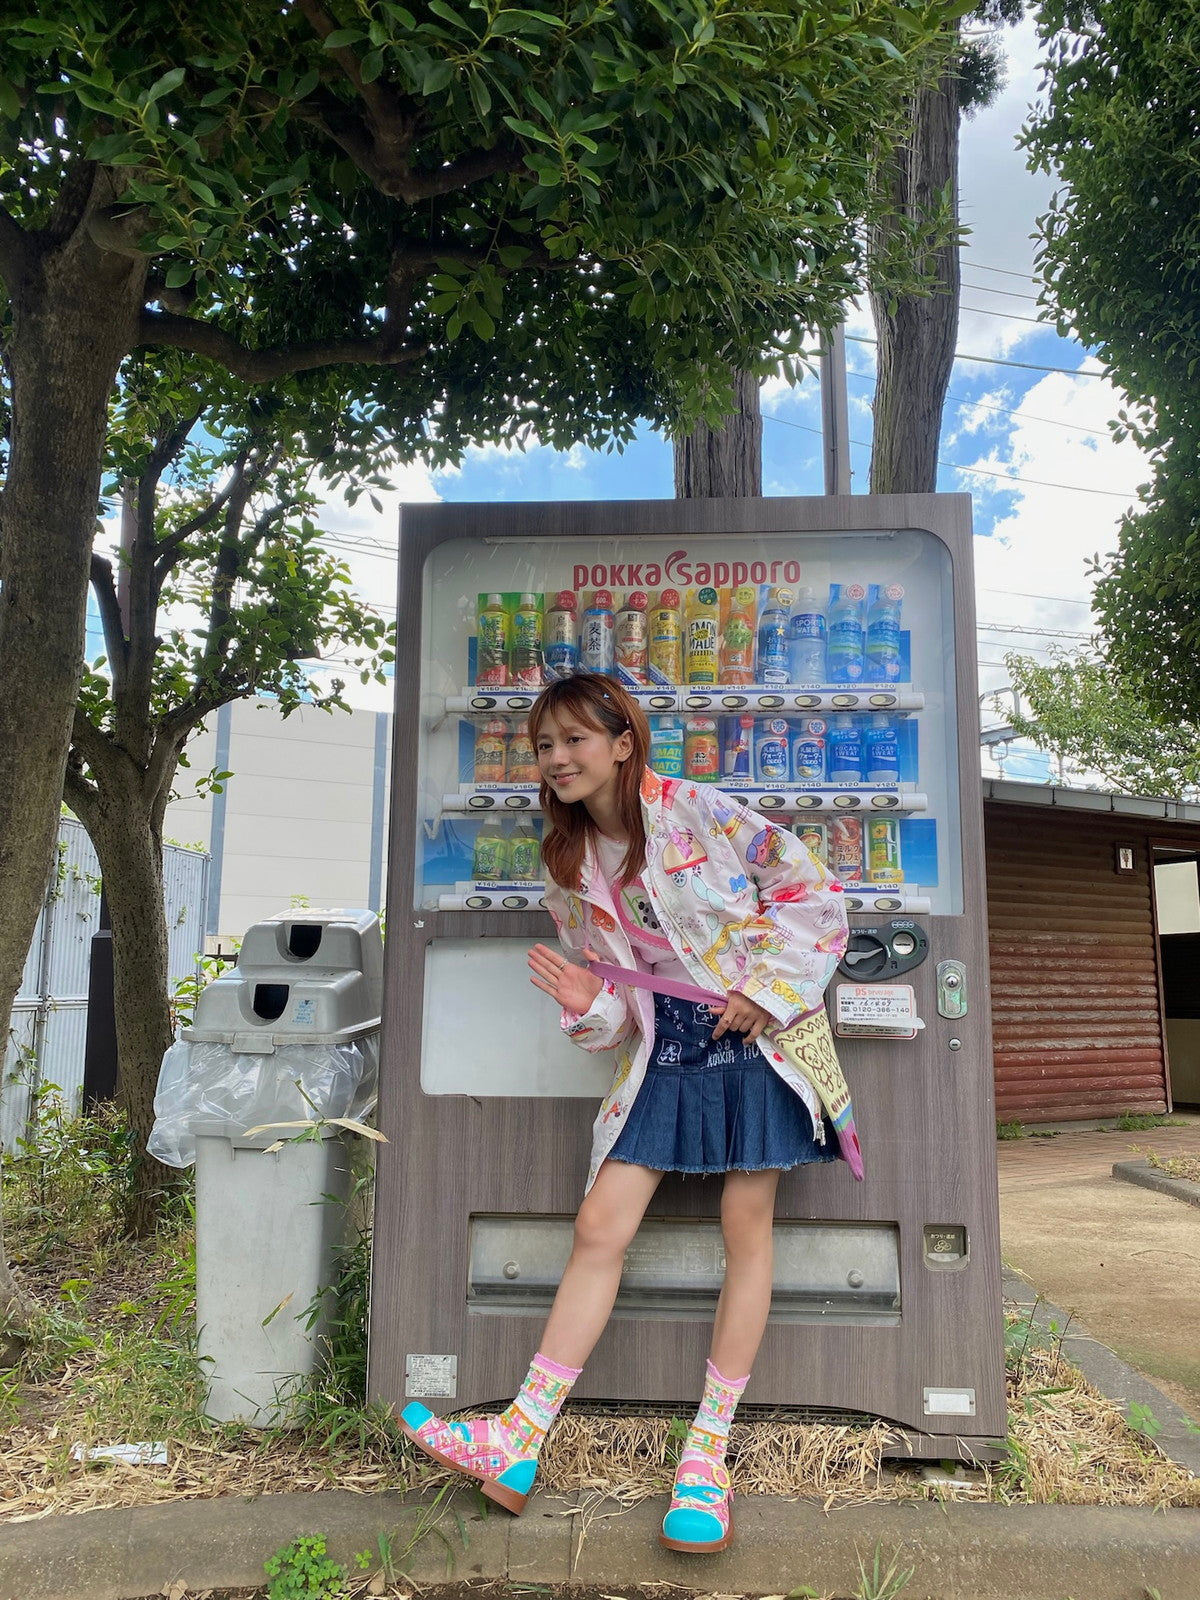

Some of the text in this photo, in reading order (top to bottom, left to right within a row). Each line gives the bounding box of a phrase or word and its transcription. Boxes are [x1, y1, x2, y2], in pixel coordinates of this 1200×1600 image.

[588, 622, 601, 651] 麦茶
[689, 637, 714, 649] MADE
[837, 853, 859, 861] カフェ
